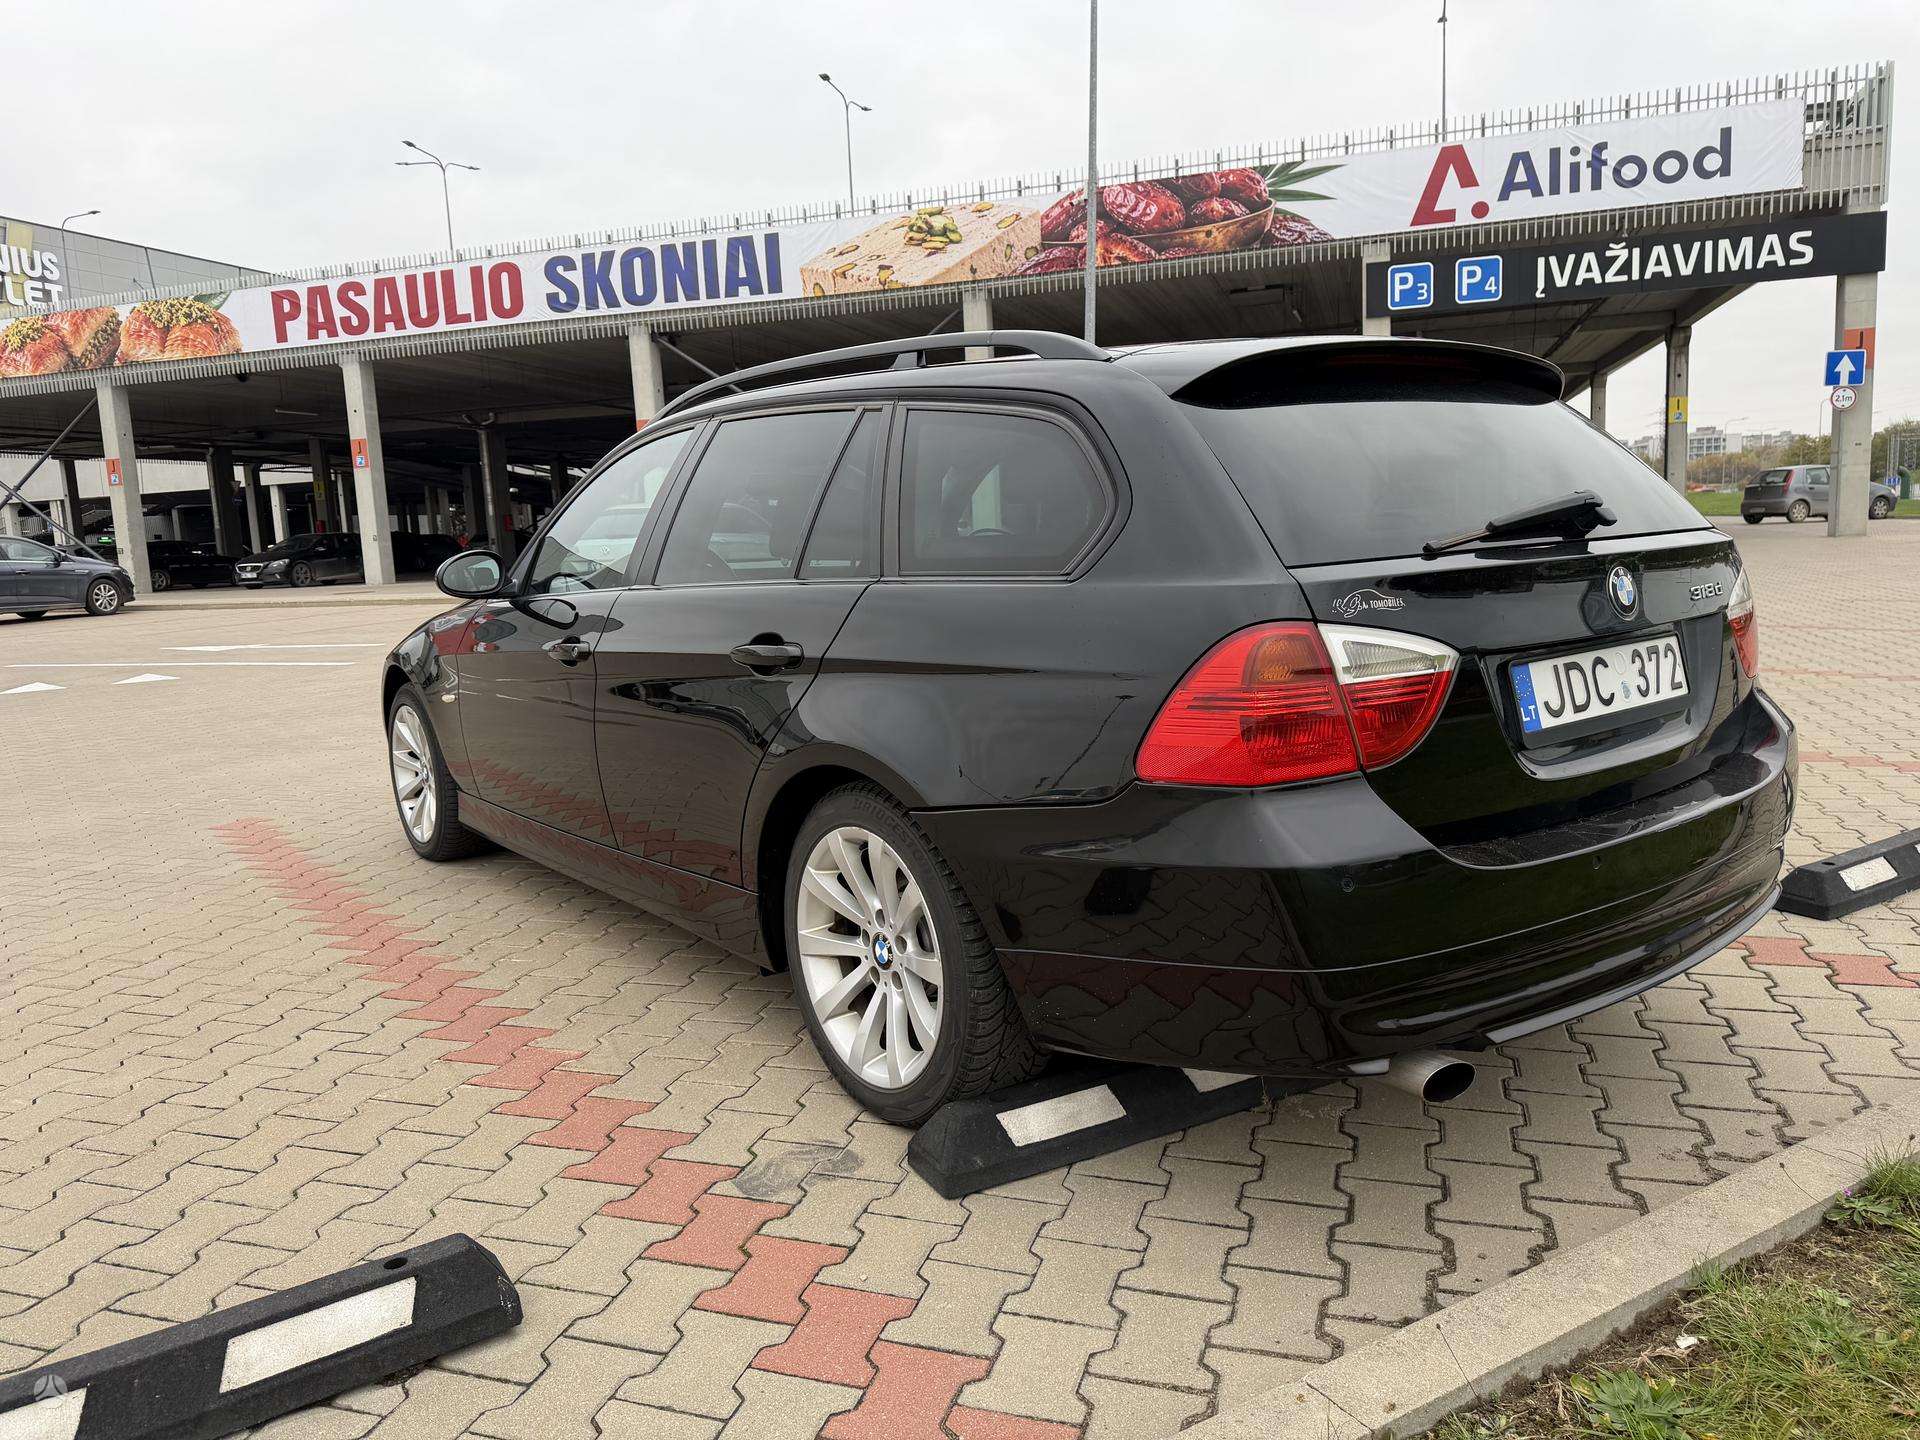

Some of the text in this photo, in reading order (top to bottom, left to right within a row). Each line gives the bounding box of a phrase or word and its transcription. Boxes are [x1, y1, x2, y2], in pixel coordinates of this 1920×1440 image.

[1497, 126, 1732, 202] Alifood
[0, 275, 63, 311] LET
[270, 232, 784, 344] PASAULIO SKONIAI
[1534, 230, 1815, 298] ĮVAŽIAVIMAS
[1690, 581, 1724, 600] 318d
[1521, 704, 1538, 722] LT
[1544, 642, 1683, 719] JDC 372
